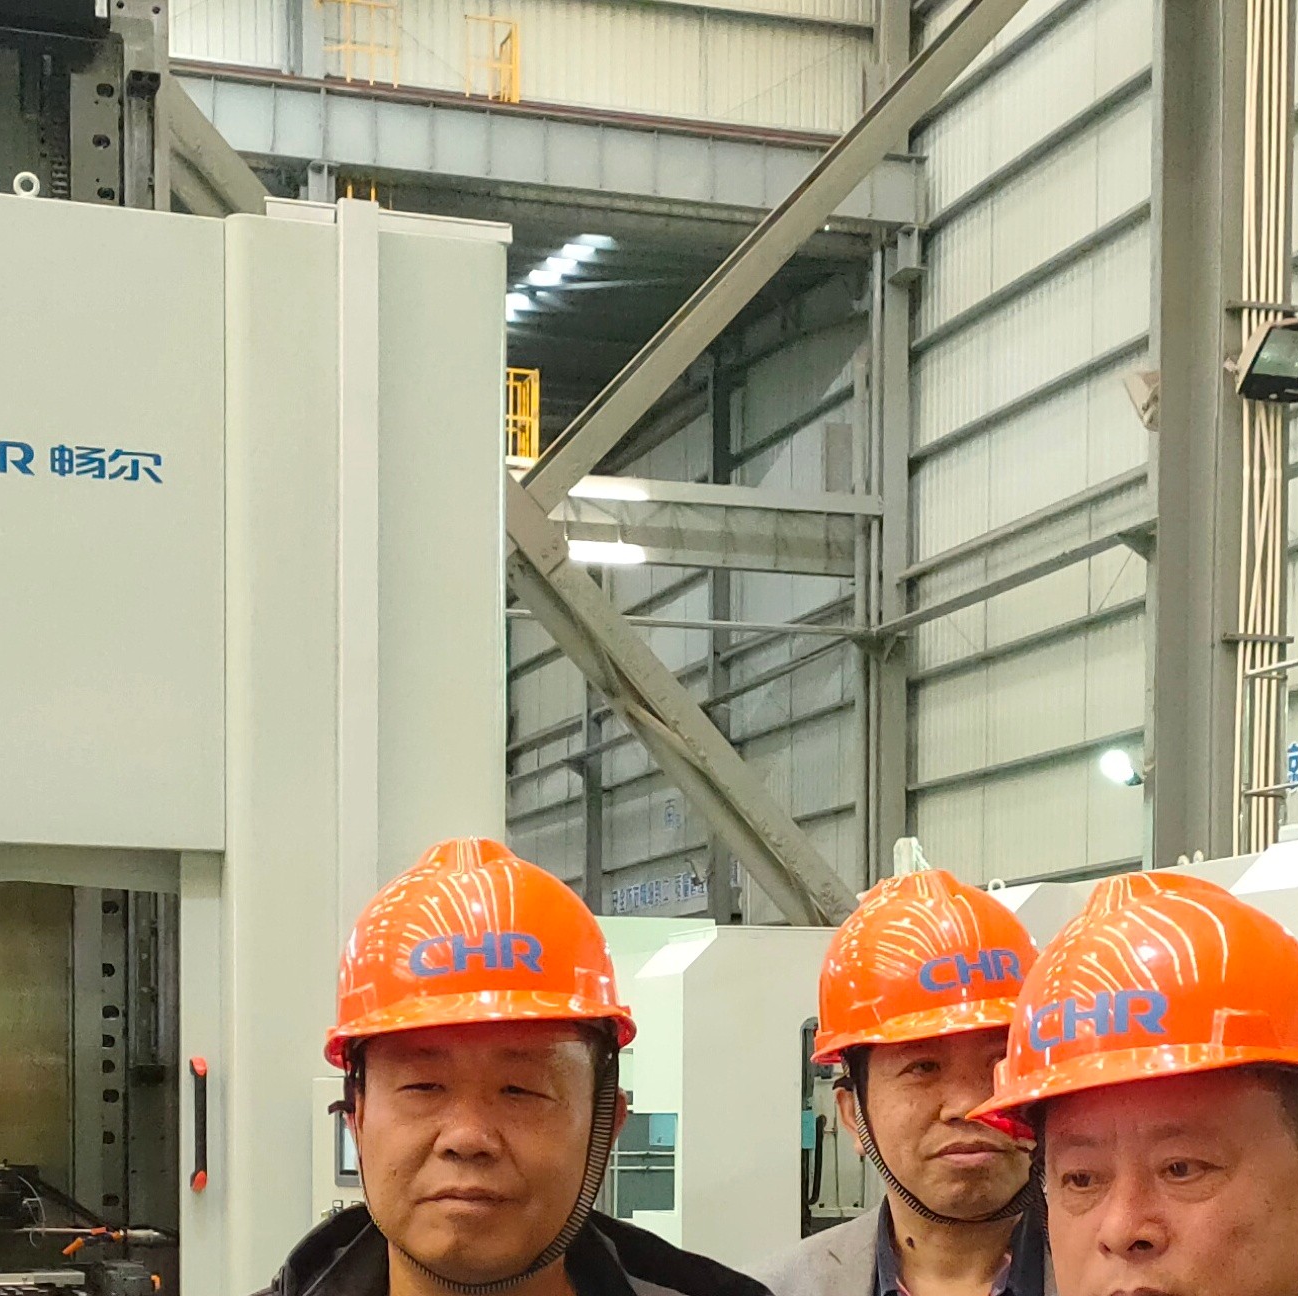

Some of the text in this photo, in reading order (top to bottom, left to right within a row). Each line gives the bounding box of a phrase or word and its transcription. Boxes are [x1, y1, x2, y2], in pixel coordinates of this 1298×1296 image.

[49, 444, 163, 484] 畅尔
[409, 931, 544, 977] CHR
[919, 949, 1026, 992] CHR
[1029, 989, 1168, 1051] CHR
